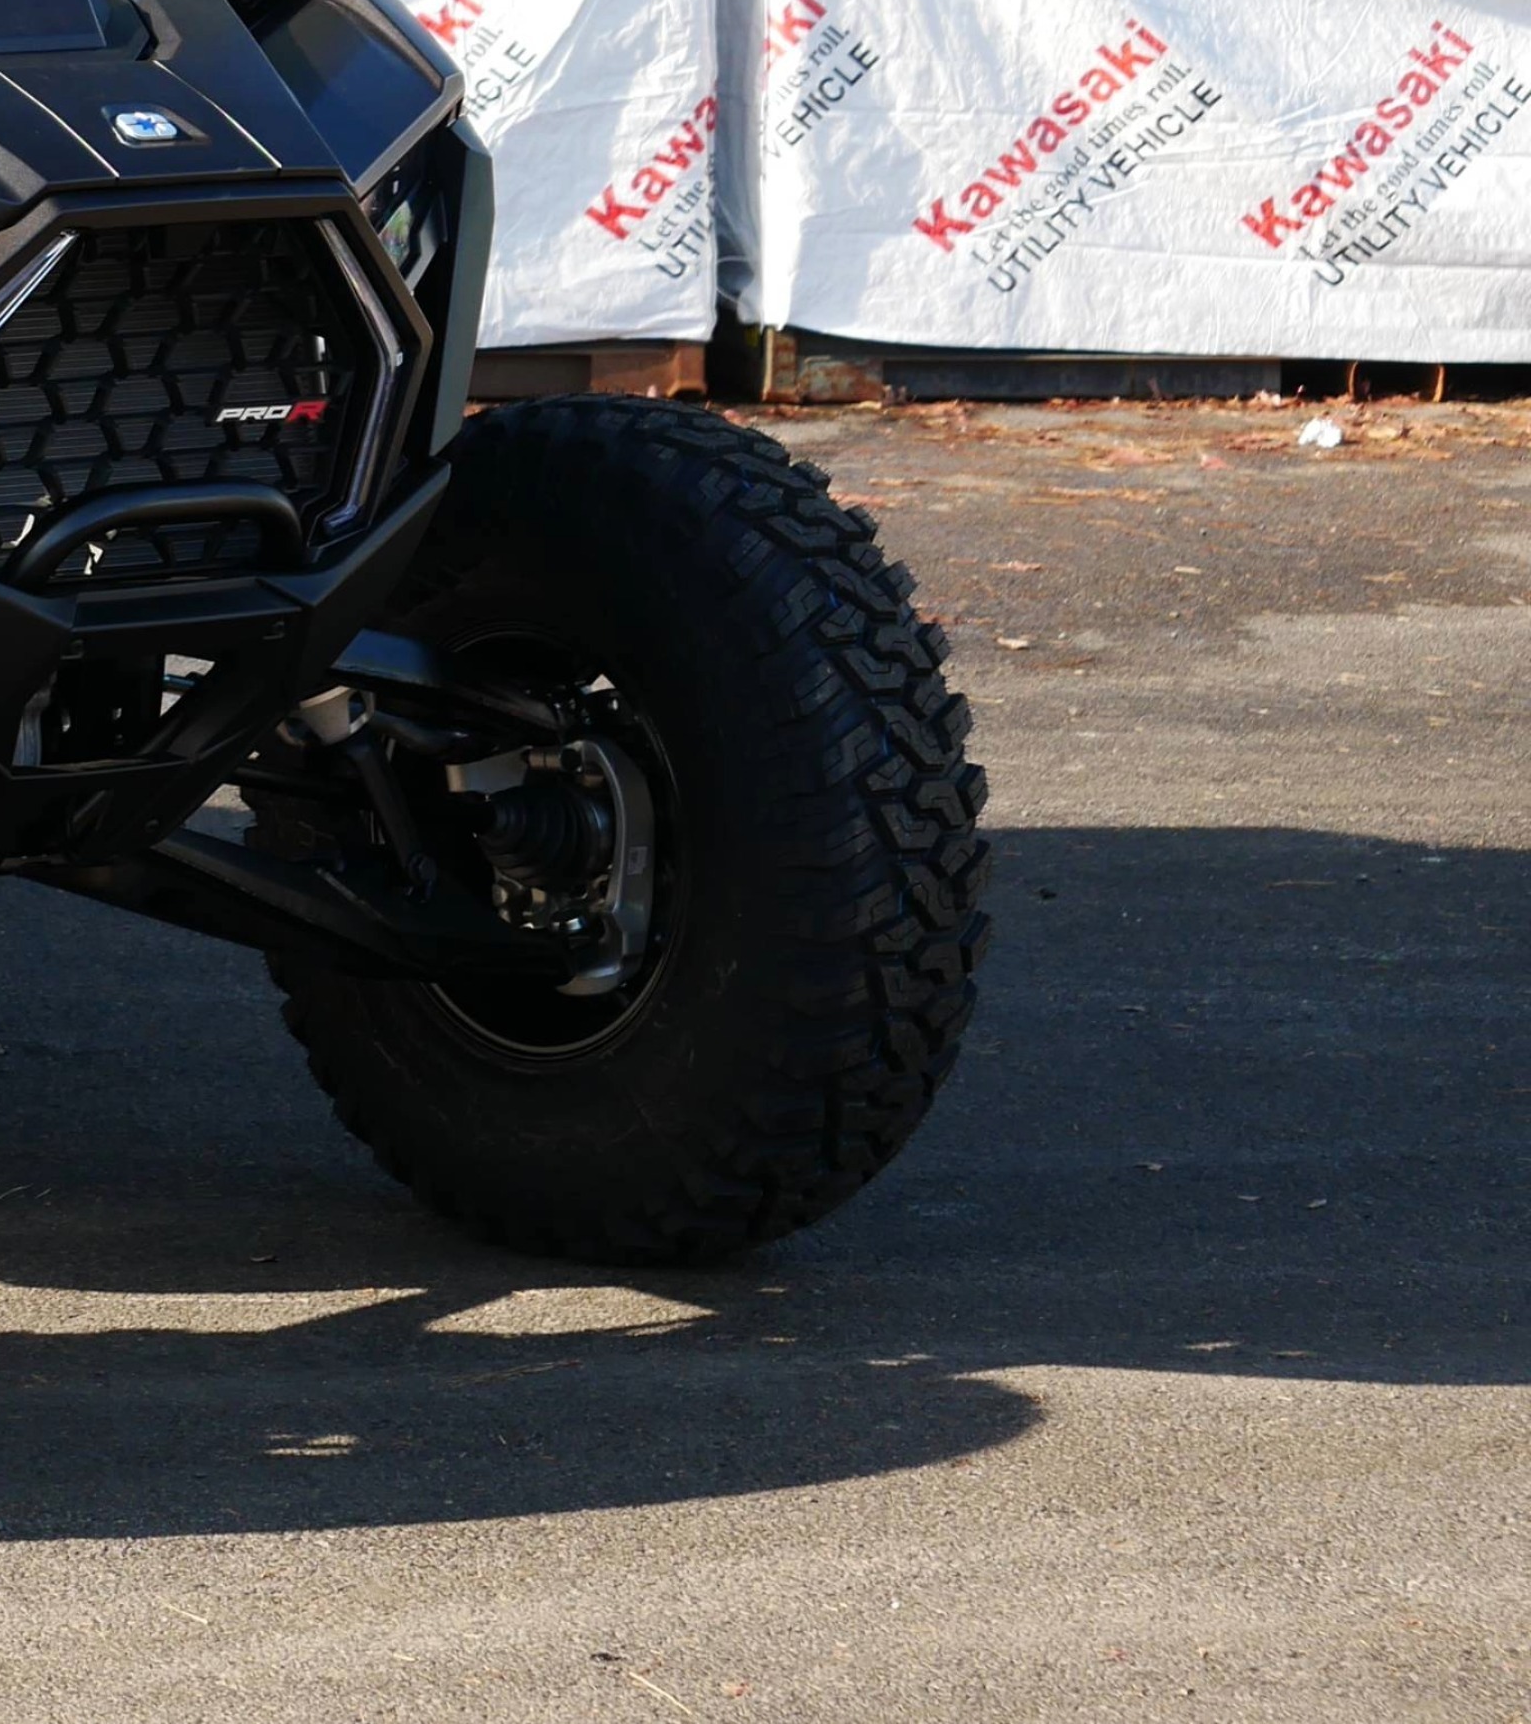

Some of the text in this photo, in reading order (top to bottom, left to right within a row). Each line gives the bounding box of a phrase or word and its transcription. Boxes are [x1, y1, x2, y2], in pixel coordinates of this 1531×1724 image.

[764, 41, 880, 159] VEHICLE
[808, 24, 851, 67] roll.
[584, 95, 719, 240] Kawa
[639, 179, 708, 252] Let the
[912, 18, 1169, 254] Kawasaki
[971, 62, 1193, 267] Let the good times roll.
[986, 79, 1223, 294] UTILITY VEHICLE
[1241, 19, 1475, 250] Kawasaki
[1312, 76, 1531, 288] UTILITY VEHICLE
[1340, 196, 1379, 232] the
[1377, 149, 1420, 204] good
[1414, 102, 1466, 154] times
[1461, 59, 1502, 102] roll.
[216, 400, 328, 424] PRO R
